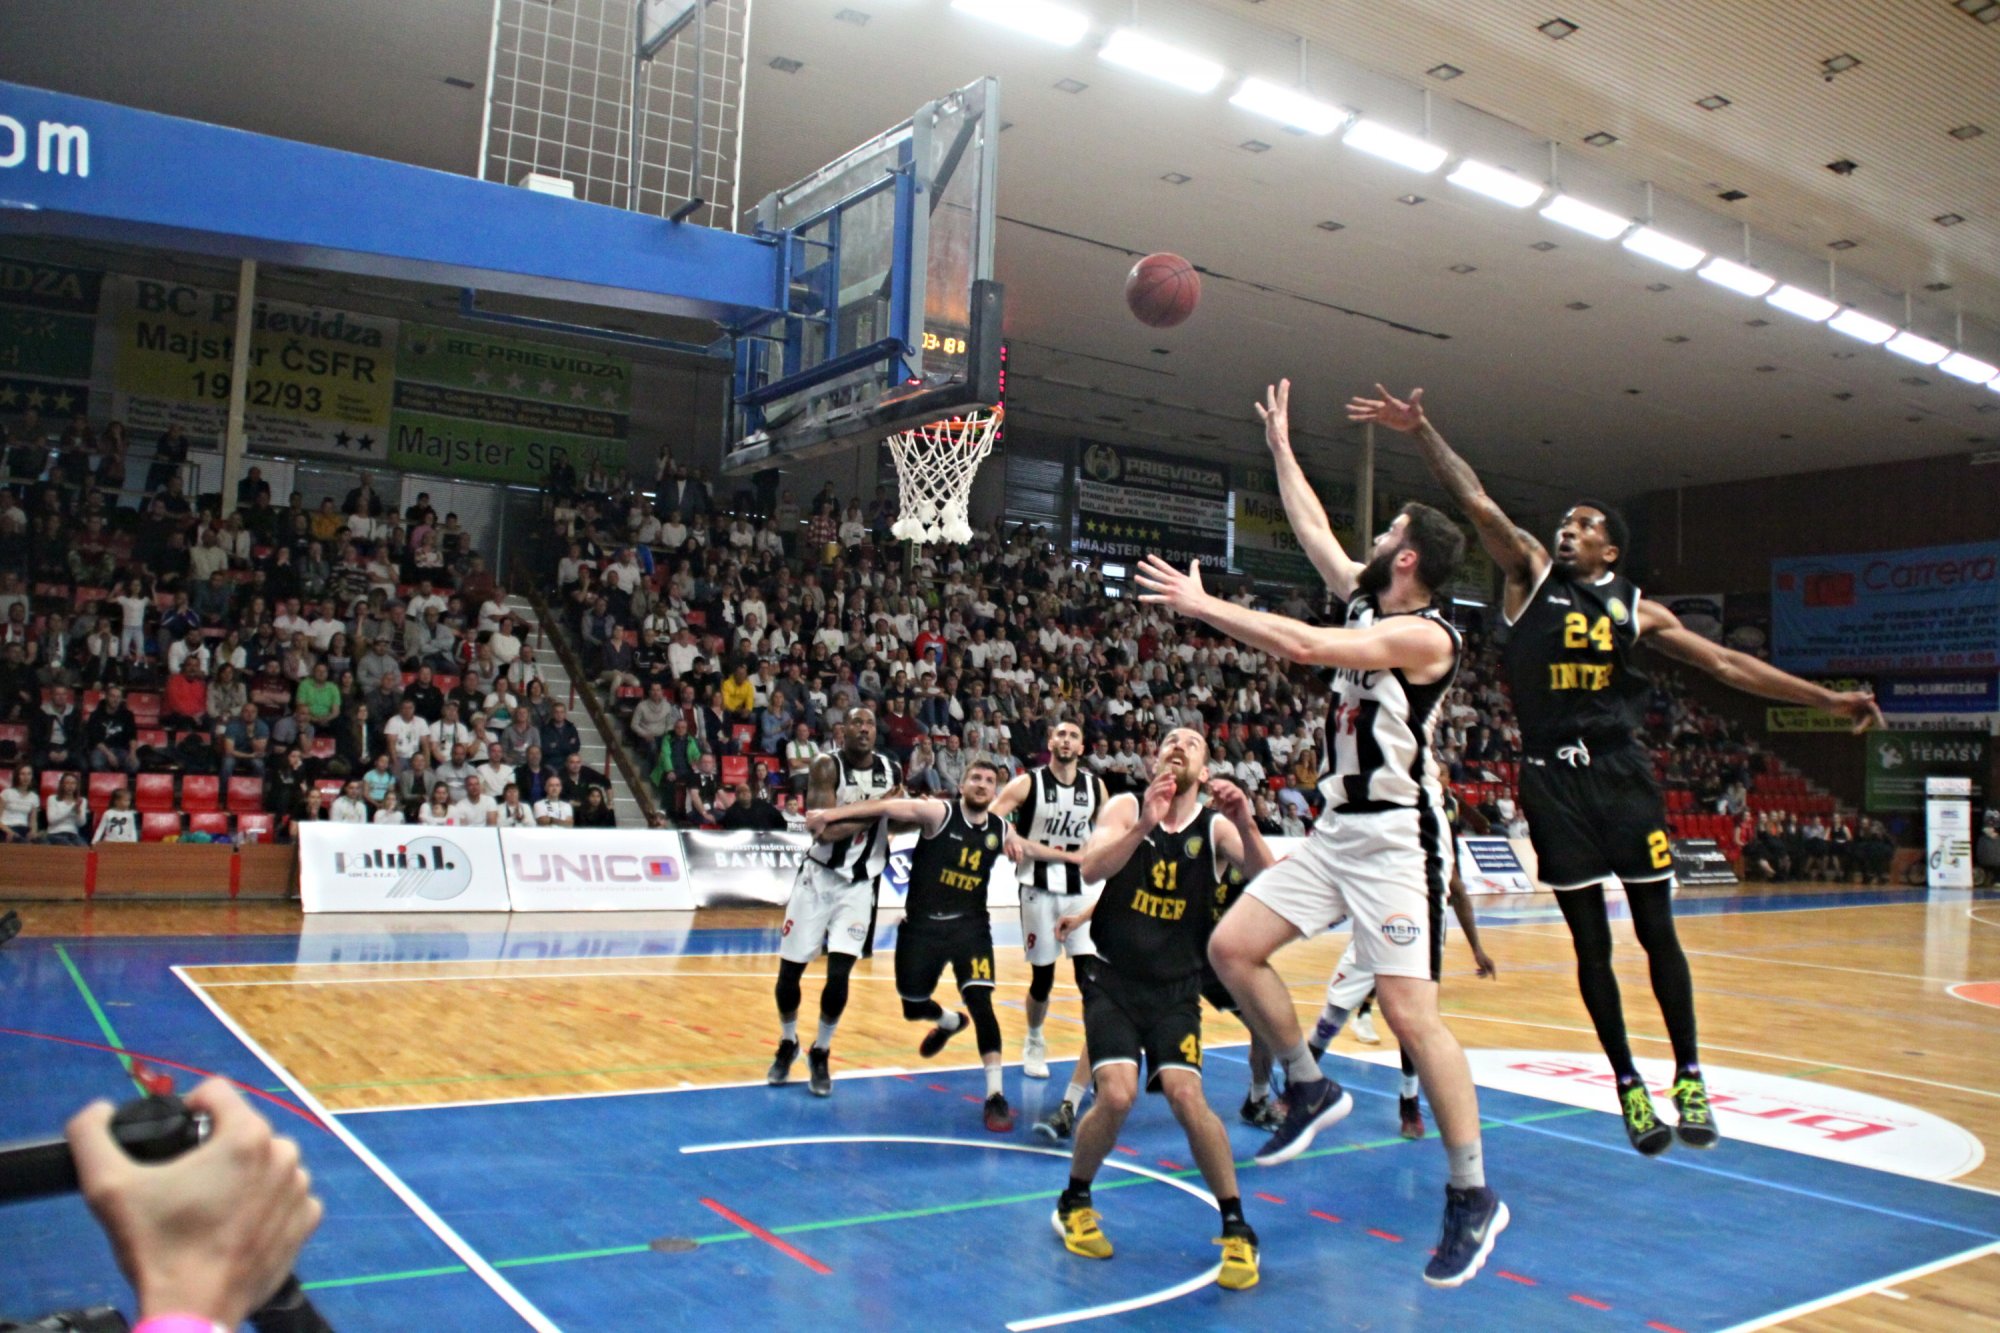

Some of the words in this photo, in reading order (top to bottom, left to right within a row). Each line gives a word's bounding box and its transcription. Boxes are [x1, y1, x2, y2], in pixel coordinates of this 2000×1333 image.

[136, 280, 197, 318] BC
[212, 293, 382, 348] Pievidza
[136, 321, 269, 363] Majstr
[280, 337, 376, 384] ČSFR
[448, 339, 483, 358] BC
[488, 346, 624, 380] PRIEVIDZA
[192, 371, 322, 412] 192/93
[397, 424, 516, 466] Majster
[1126, 458, 1224, 488] PRIEVIDZA
[1079, 537, 1142, 557] MAJSTER
[1271, 531, 1306, 552] 198
[1861, 555, 1996, 591] Carrera
[1564, 612, 1614, 651] 24
[1910, 748, 1983, 762] TERASY
[1044, 810, 1087, 839] niké
[512, 853, 681, 883] UNICO
[958, 846, 983, 871] 14
[1151, 858, 1178, 890] 41
[1381, 924, 1421, 937] msm
[971, 957, 991, 980] 14
